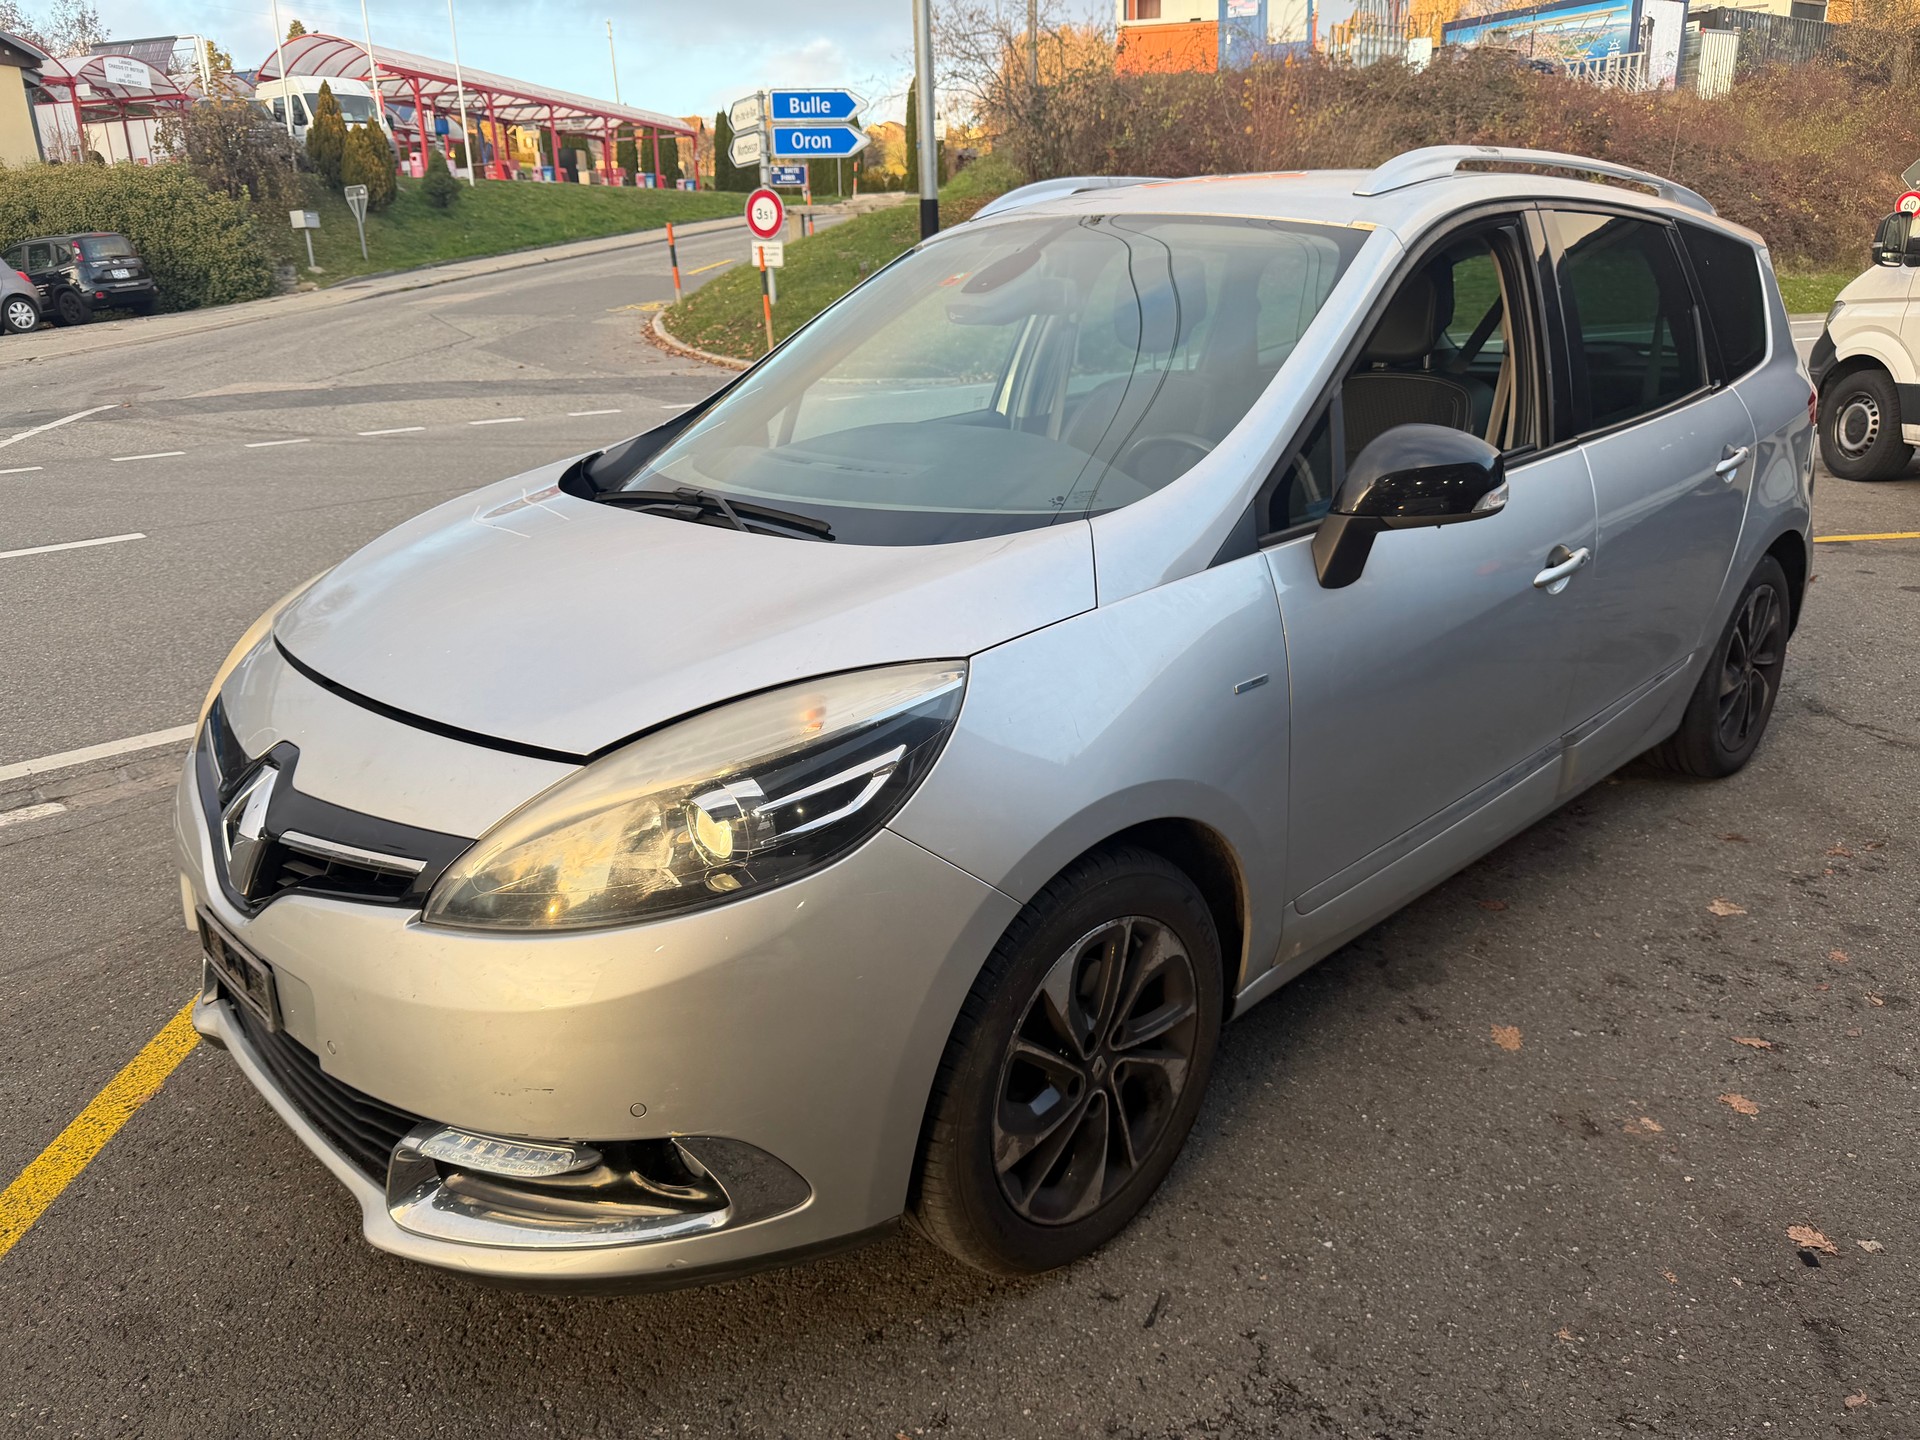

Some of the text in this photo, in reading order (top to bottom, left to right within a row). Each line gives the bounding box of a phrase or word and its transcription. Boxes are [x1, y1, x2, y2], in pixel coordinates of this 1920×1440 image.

[789, 96, 831, 114] Bulle
[791, 131, 832, 149] Oron
[1904, 200, 1917, 210] 60
